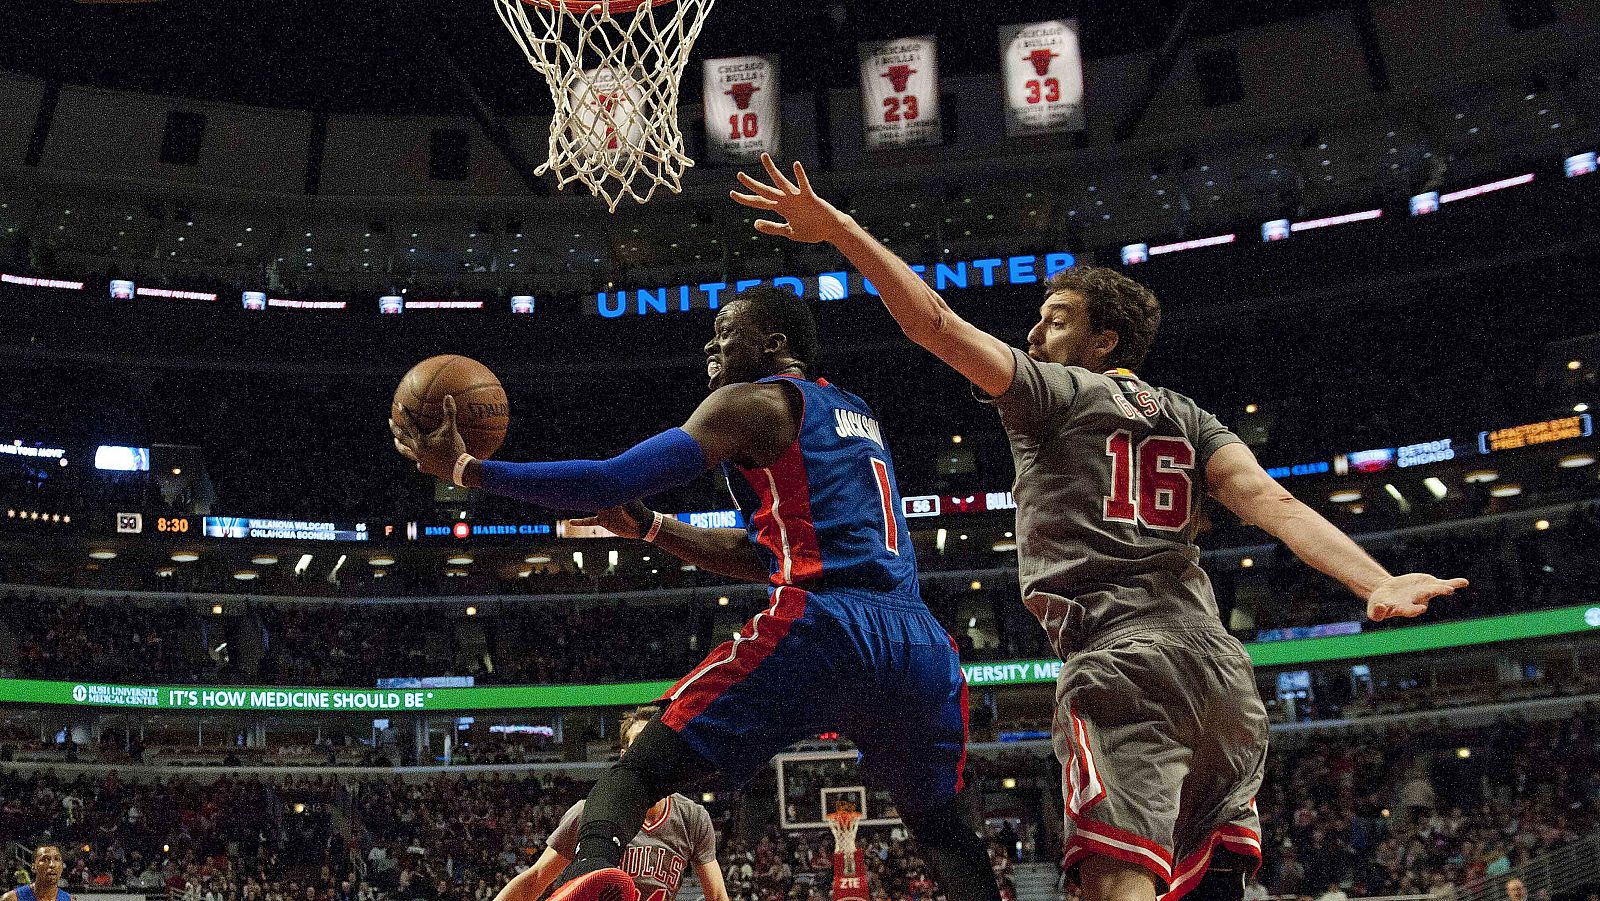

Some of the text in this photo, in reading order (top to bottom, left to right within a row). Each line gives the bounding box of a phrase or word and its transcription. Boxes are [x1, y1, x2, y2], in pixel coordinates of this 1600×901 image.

[1025, 77, 1060, 104] 33
[883, 95, 919, 122] 23
[729, 113, 758, 140] 10
[835, 408, 885, 450] JACKSON
[1397, 439, 1452, 458] DETROIT
[1397, 448, 1455, 468] CHICAGO
[1103, 428, 1196, 532] 16
[870, 456, 899, 556] 1
[157, 517, 189, 533] 8:30
[250, 518, 294, 531] VILLANOVA
[295, 522, 335, 531] WILDCATS
[385, 525, 394, 536] F
[425, 524, 551, 536] BMO HARRIS CLUB
[690, 515, 737, 529] PISTONS
[250, 529, 296, 539] OKLAHOMA
[1034, 662, 1064, 679] ME
[88, 694, 159, 706] MEDICAL CENTER
[111, 686, 159, 697] UNIVERSITY
[202, 691, 246, 706] HOW
[250, 692, 329, 707] MEDICINE
[333, 692, 400, 708] SHOULD
[840, 877, 861, 889] ZTE
